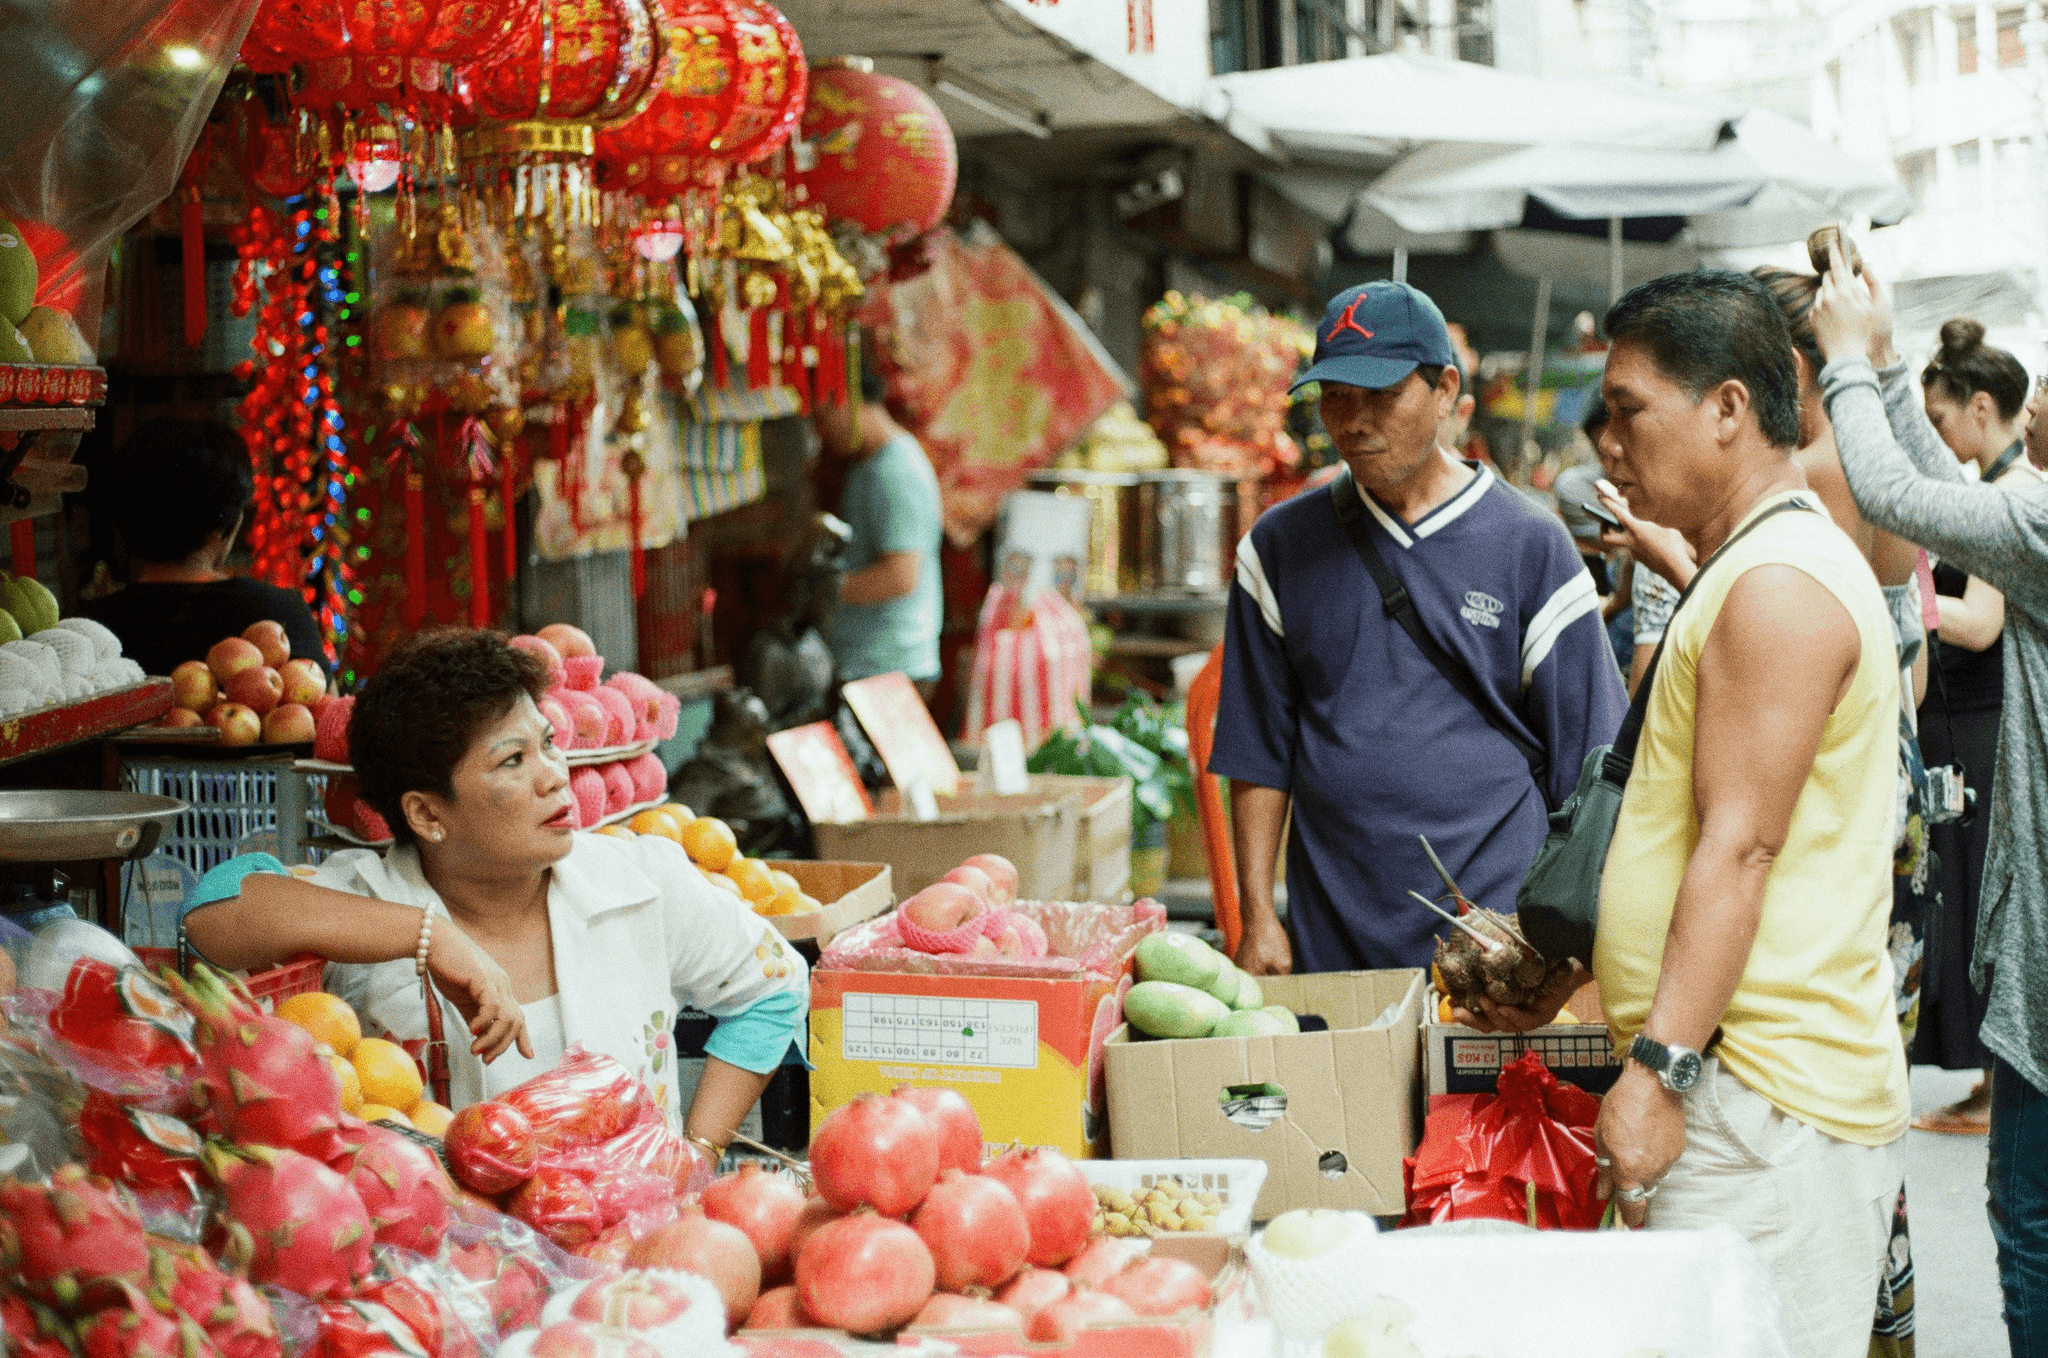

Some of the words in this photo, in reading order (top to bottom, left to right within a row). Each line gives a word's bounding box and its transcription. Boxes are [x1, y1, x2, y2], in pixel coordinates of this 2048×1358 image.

[873, 1016, 892, 1025] 198
[897, 1017, 916, 1026] 175
[919, 1018, 939, 1027] 163
[943, 1020, 963, 1028] 150
[1000, 1037, 1022, 1046] SIZE
[849, 1045, 868, 1053] 125
[873, 1046, 892, 1055] 113
[897, 1047, 916, 1056] 100
[923, 1048, 936, 1057] 88
[946, 1049, 960, 1058] 80
[969, 1051, 983, 1059] 72
[1456, 1053, 1481, 1064] KGS
[1483, 1053, 1497, 1063] 13
[921, 1067, 939, 1081] OF
[940, 1068, 1001, 1084] PRODUCT
